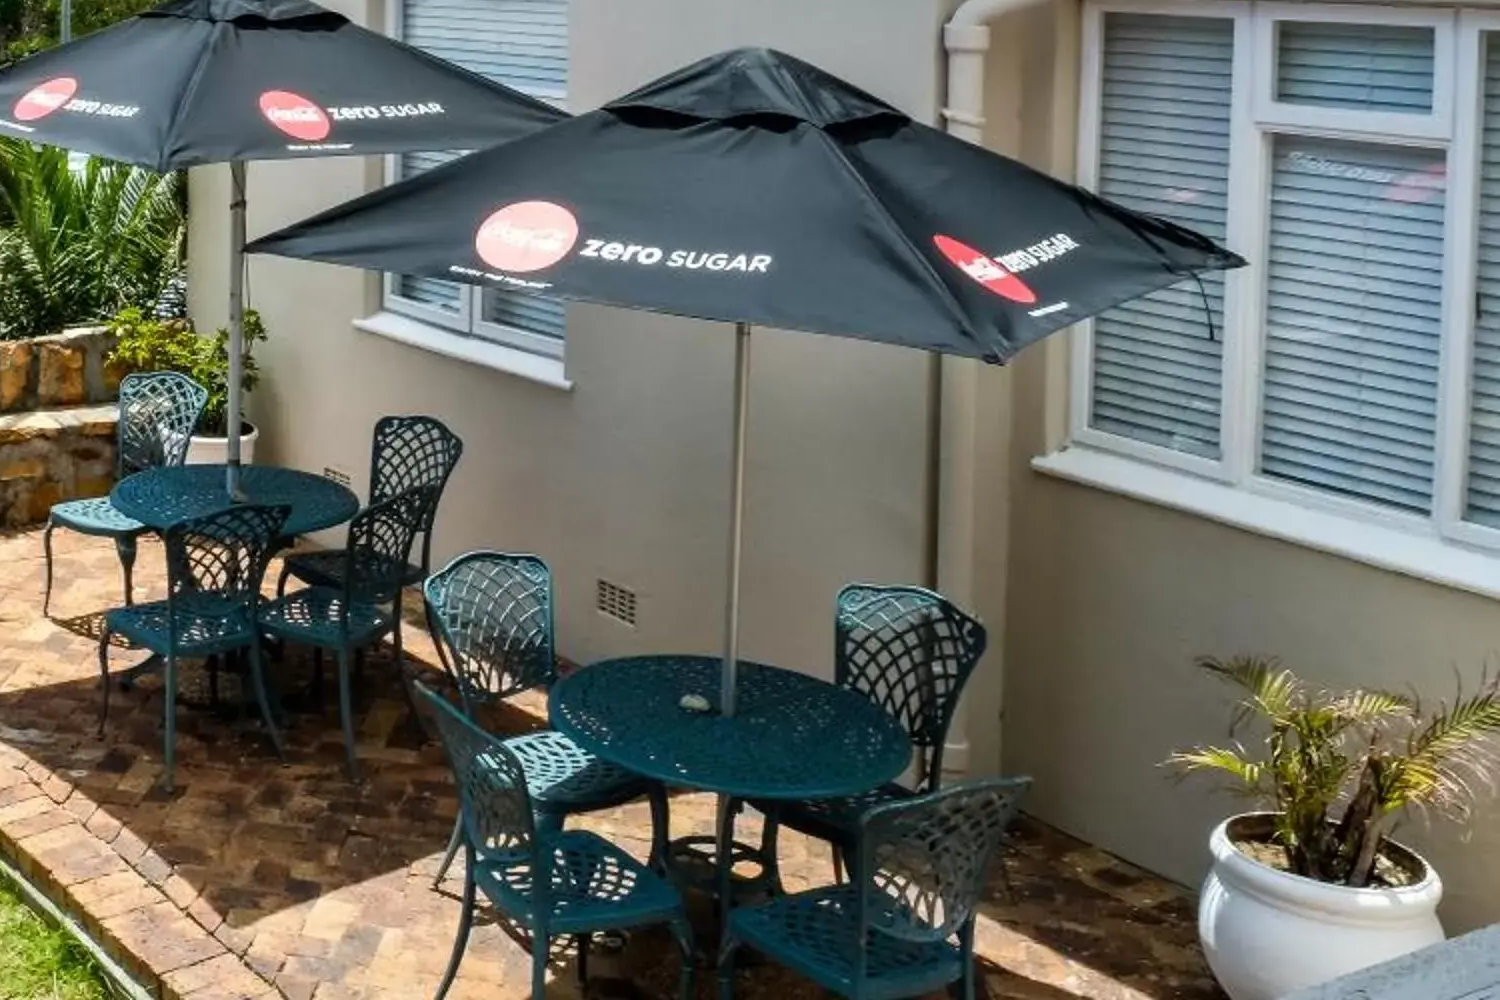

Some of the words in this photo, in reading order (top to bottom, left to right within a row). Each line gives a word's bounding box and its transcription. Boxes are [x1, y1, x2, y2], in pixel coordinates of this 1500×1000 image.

[327, 106, 380, 120] zero
[380, 101, 445, 118] SUGAR
[579, 238, 664, 266] zero
[665, 250, 773, 273] SUGAR
